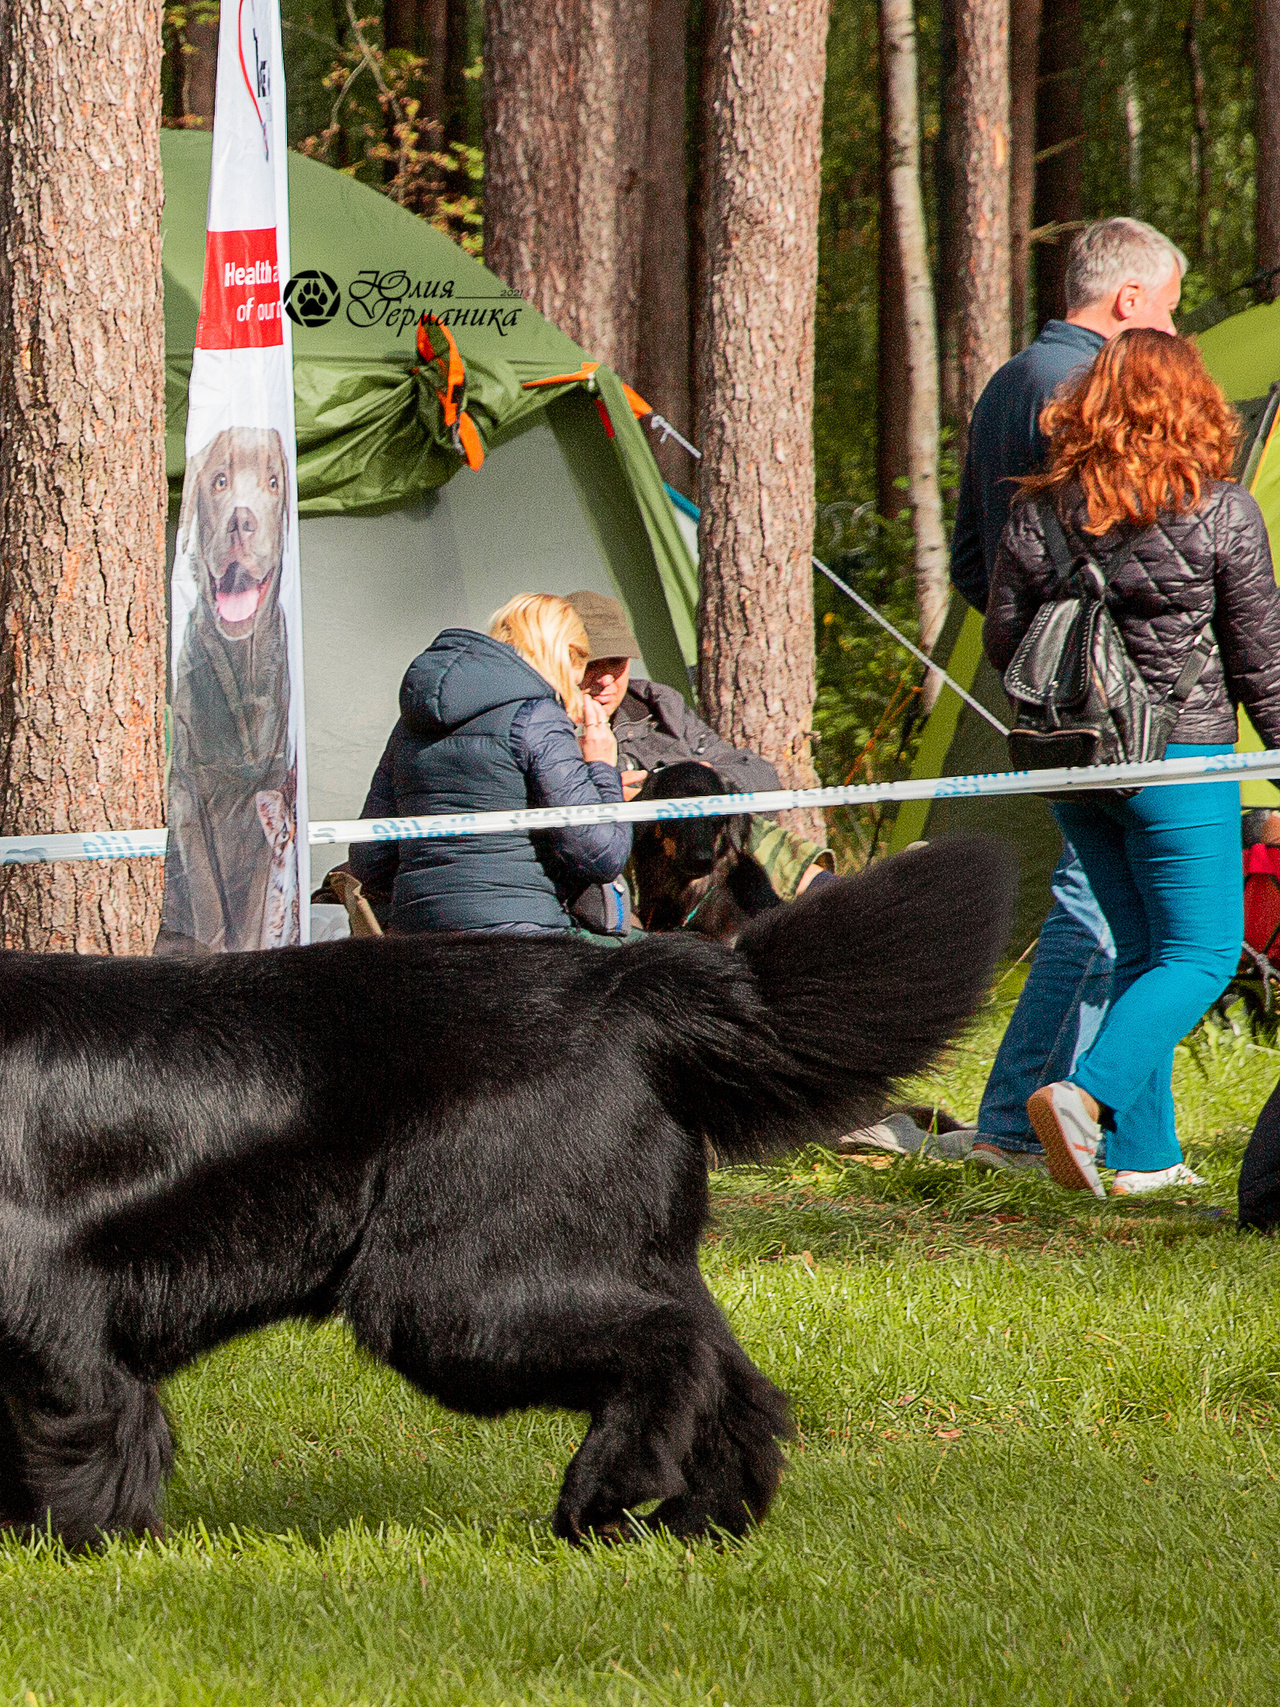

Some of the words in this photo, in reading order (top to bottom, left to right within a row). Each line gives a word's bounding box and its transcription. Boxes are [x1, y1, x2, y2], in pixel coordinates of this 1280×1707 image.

[224, 260, 272, 287] Health
[236, 296, 255, 322] of
[257, 301, 276, 321] our
